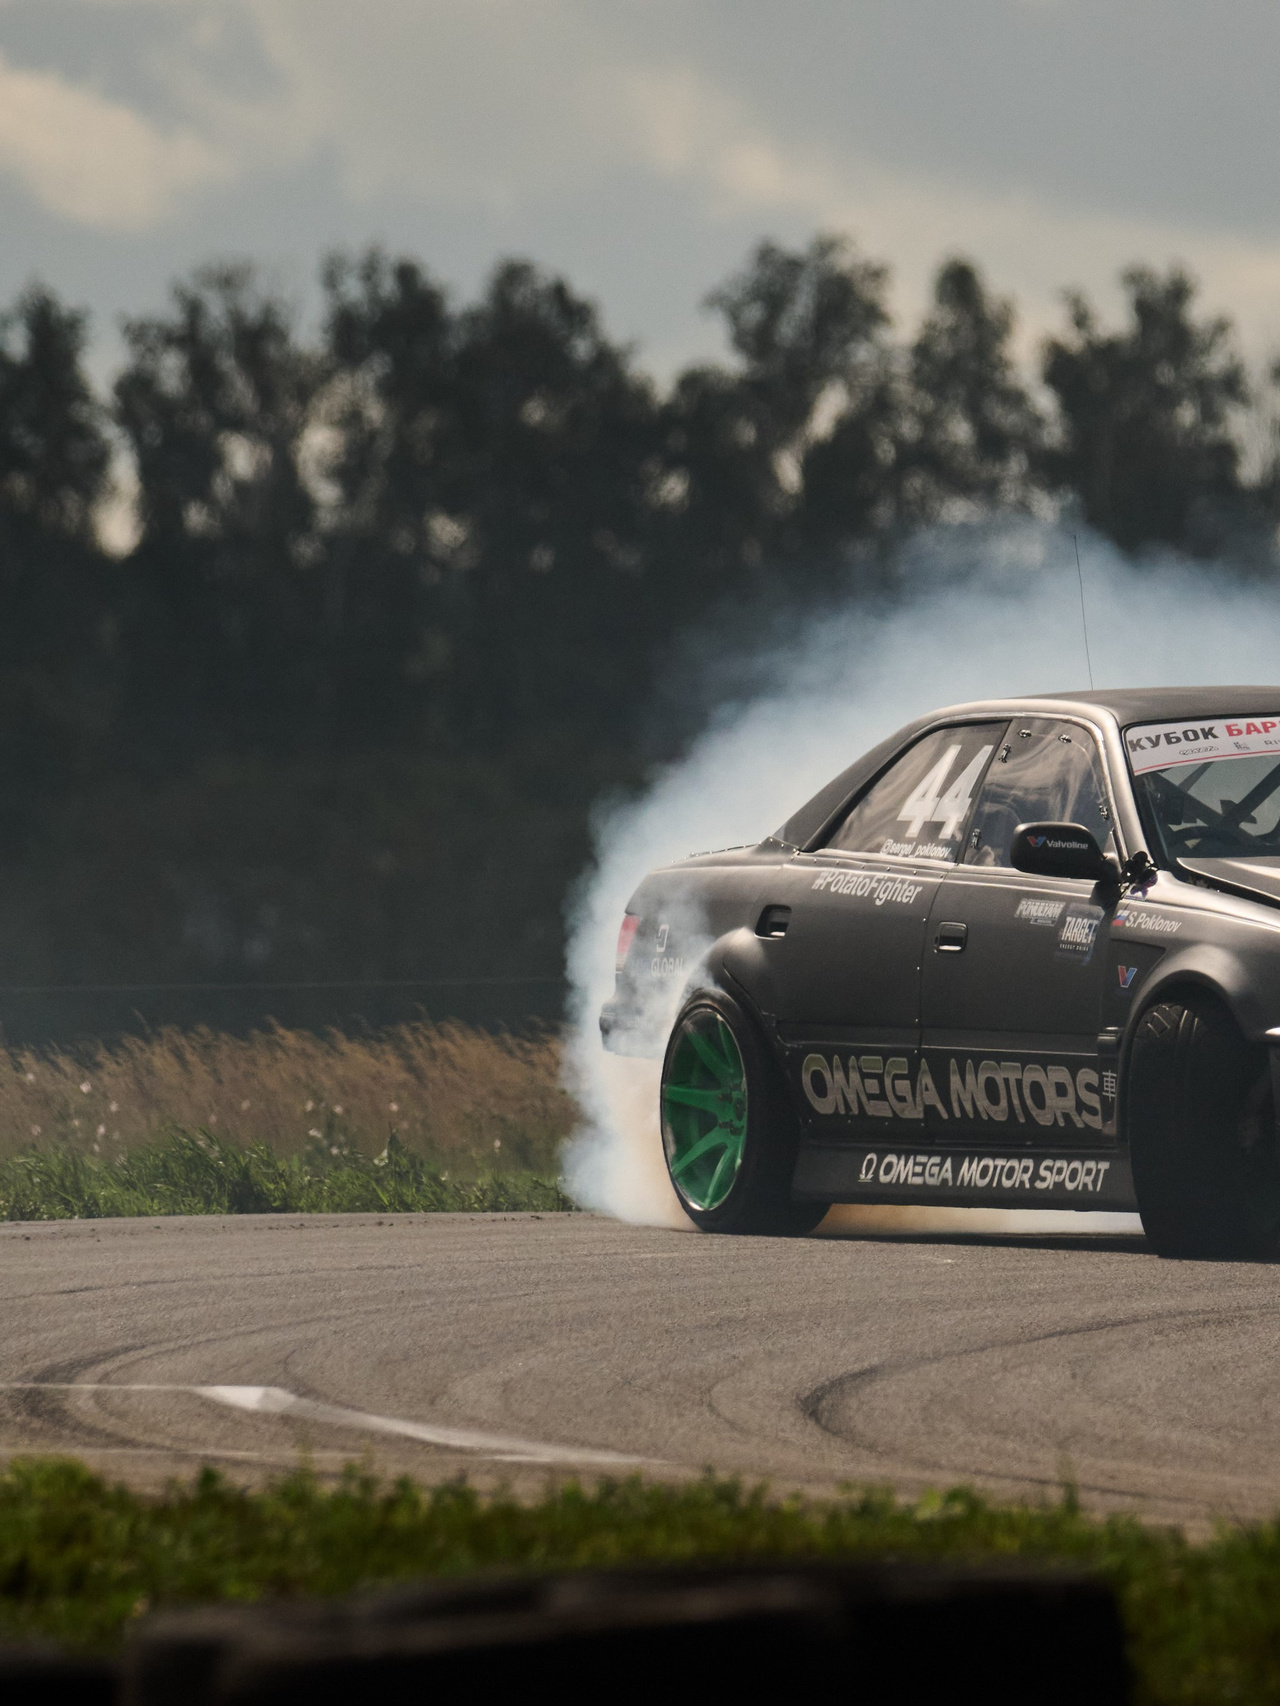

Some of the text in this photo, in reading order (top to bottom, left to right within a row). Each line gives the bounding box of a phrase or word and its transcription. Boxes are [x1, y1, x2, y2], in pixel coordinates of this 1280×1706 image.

[1127, 726, 1220, 752] КУБОК
[896, 744, 994, 840] 44
[1046, 839, 1089, 850] Valvoline
[811, 870, 923, 906] #PotatoFighter
[1061, 916, 1099, 944] TARGET
[1125, 911, 1182, 933] S.Poklonov
[651, 957, 683, 978] GLOBAL
[802, 1053, 1103, 1130] OMEGA MOTORS
[879, 1153, 1110, 1192] OMEGA MOTOR SPORT
